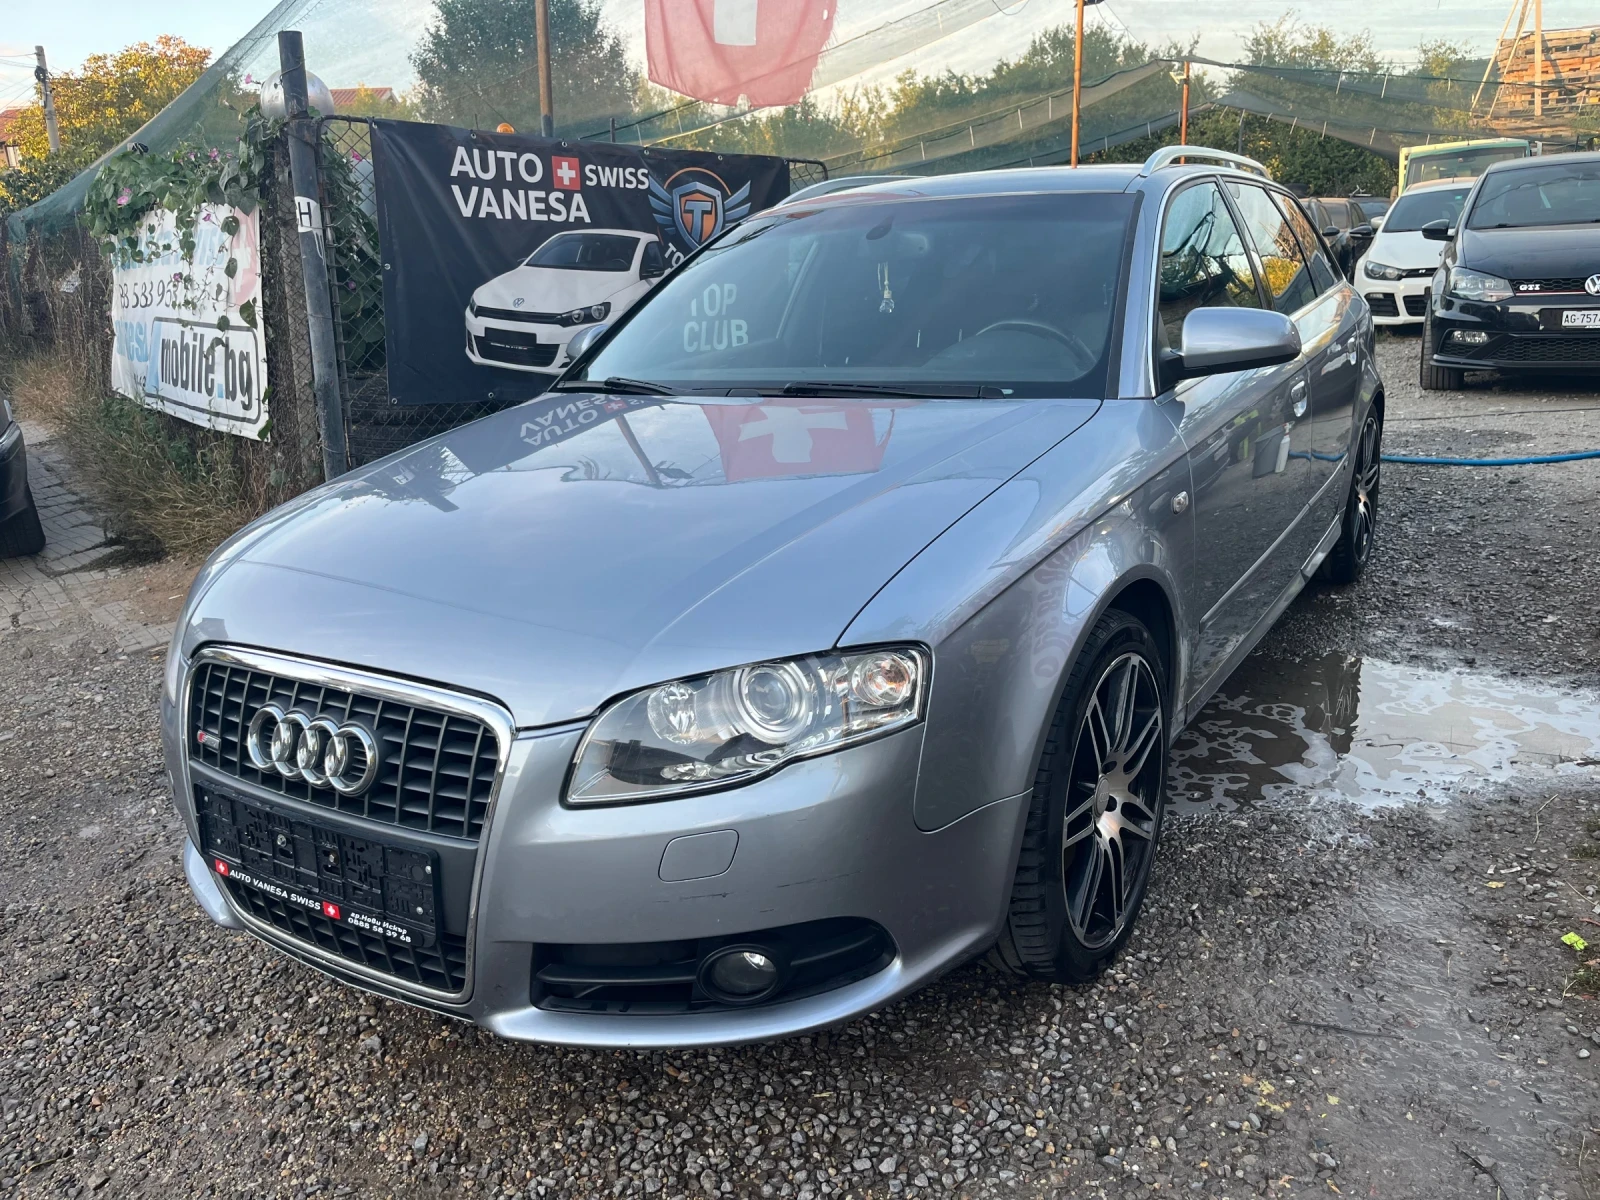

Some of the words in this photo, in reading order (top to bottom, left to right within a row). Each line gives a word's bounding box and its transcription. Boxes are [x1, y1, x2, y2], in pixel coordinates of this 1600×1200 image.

[450, 145, 544, 183] AUTO
[584, 164, 650, 190] SWISS
[450, 184, 592, 224] VANESA
[1518, 283, 1541, 291] GTI
[683, 319, 749, 353] CLUB
[161, 330, 254, 412] mobile.bg
[229, 869, 251, 883] AUTO
[253, 879, 288, 899] VANESA
[290, 893, 321, 911] SWISS
[347, 917, 370, 930] 0888
[372, 924, 384, 934] 58
[385, 928, 398, 938] 39
